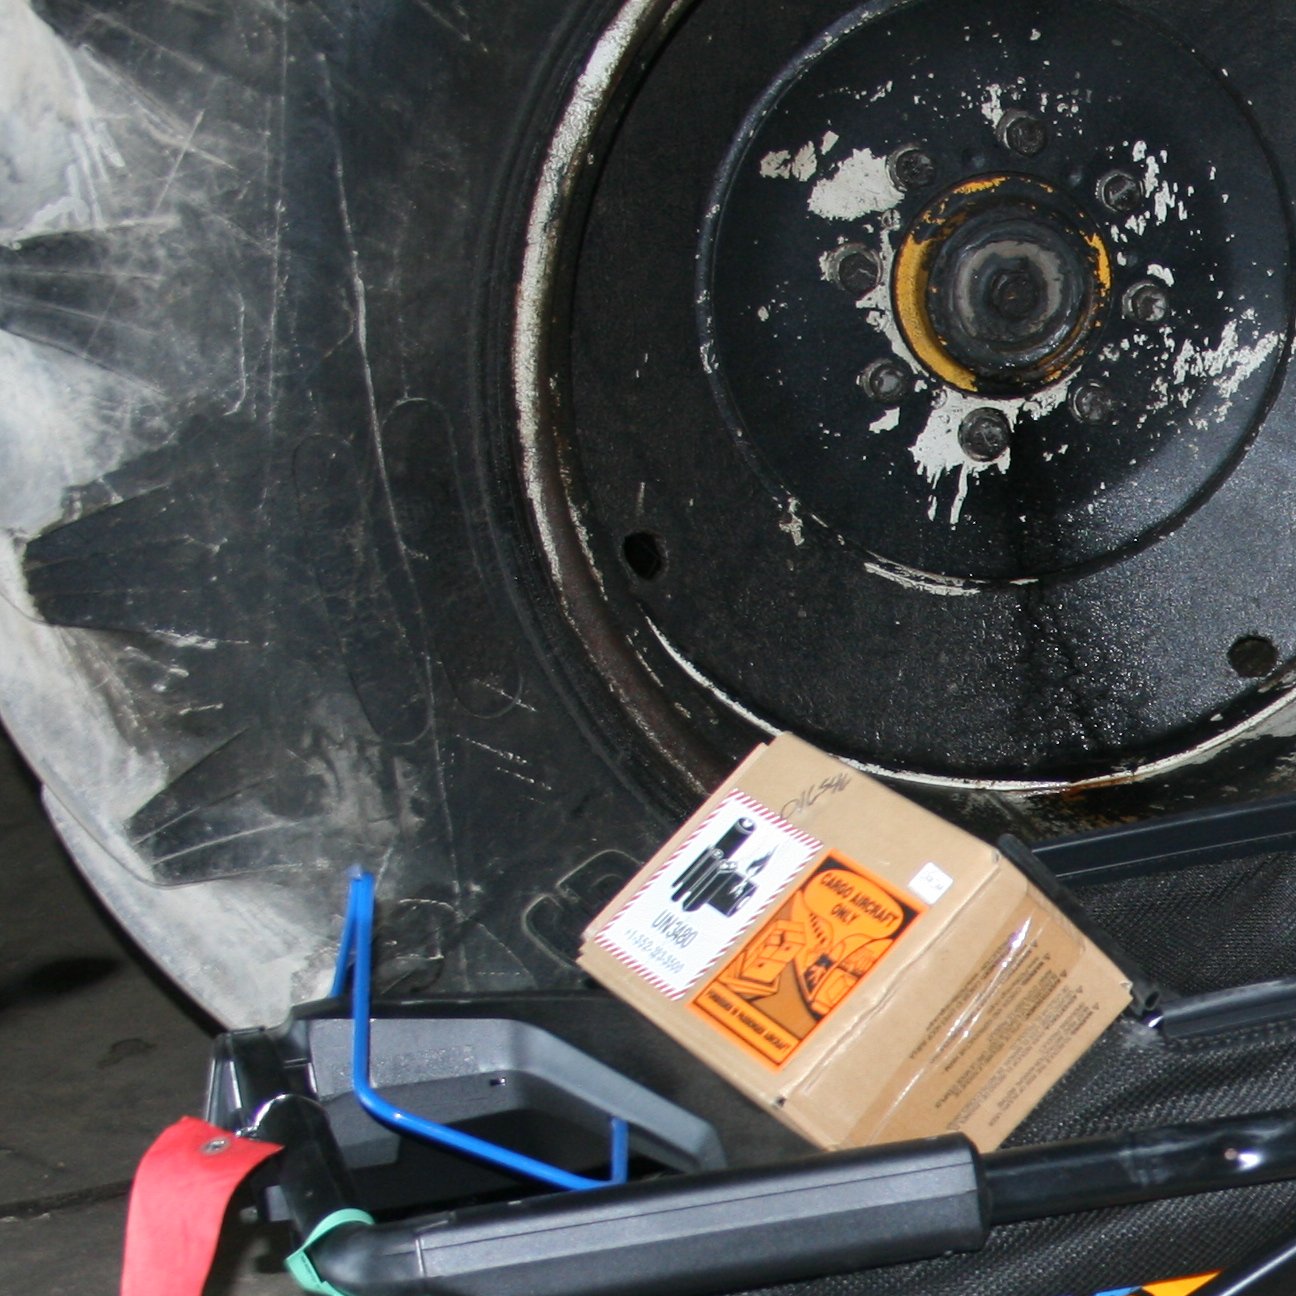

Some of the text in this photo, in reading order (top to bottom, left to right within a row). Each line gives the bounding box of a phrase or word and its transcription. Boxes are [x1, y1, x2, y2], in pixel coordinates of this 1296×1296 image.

[820, 872, 899, 929] CARGO AIRCRAFT
[831, 902, 861, 925] ONLY
[652, 908, 699, 949] UN3480
